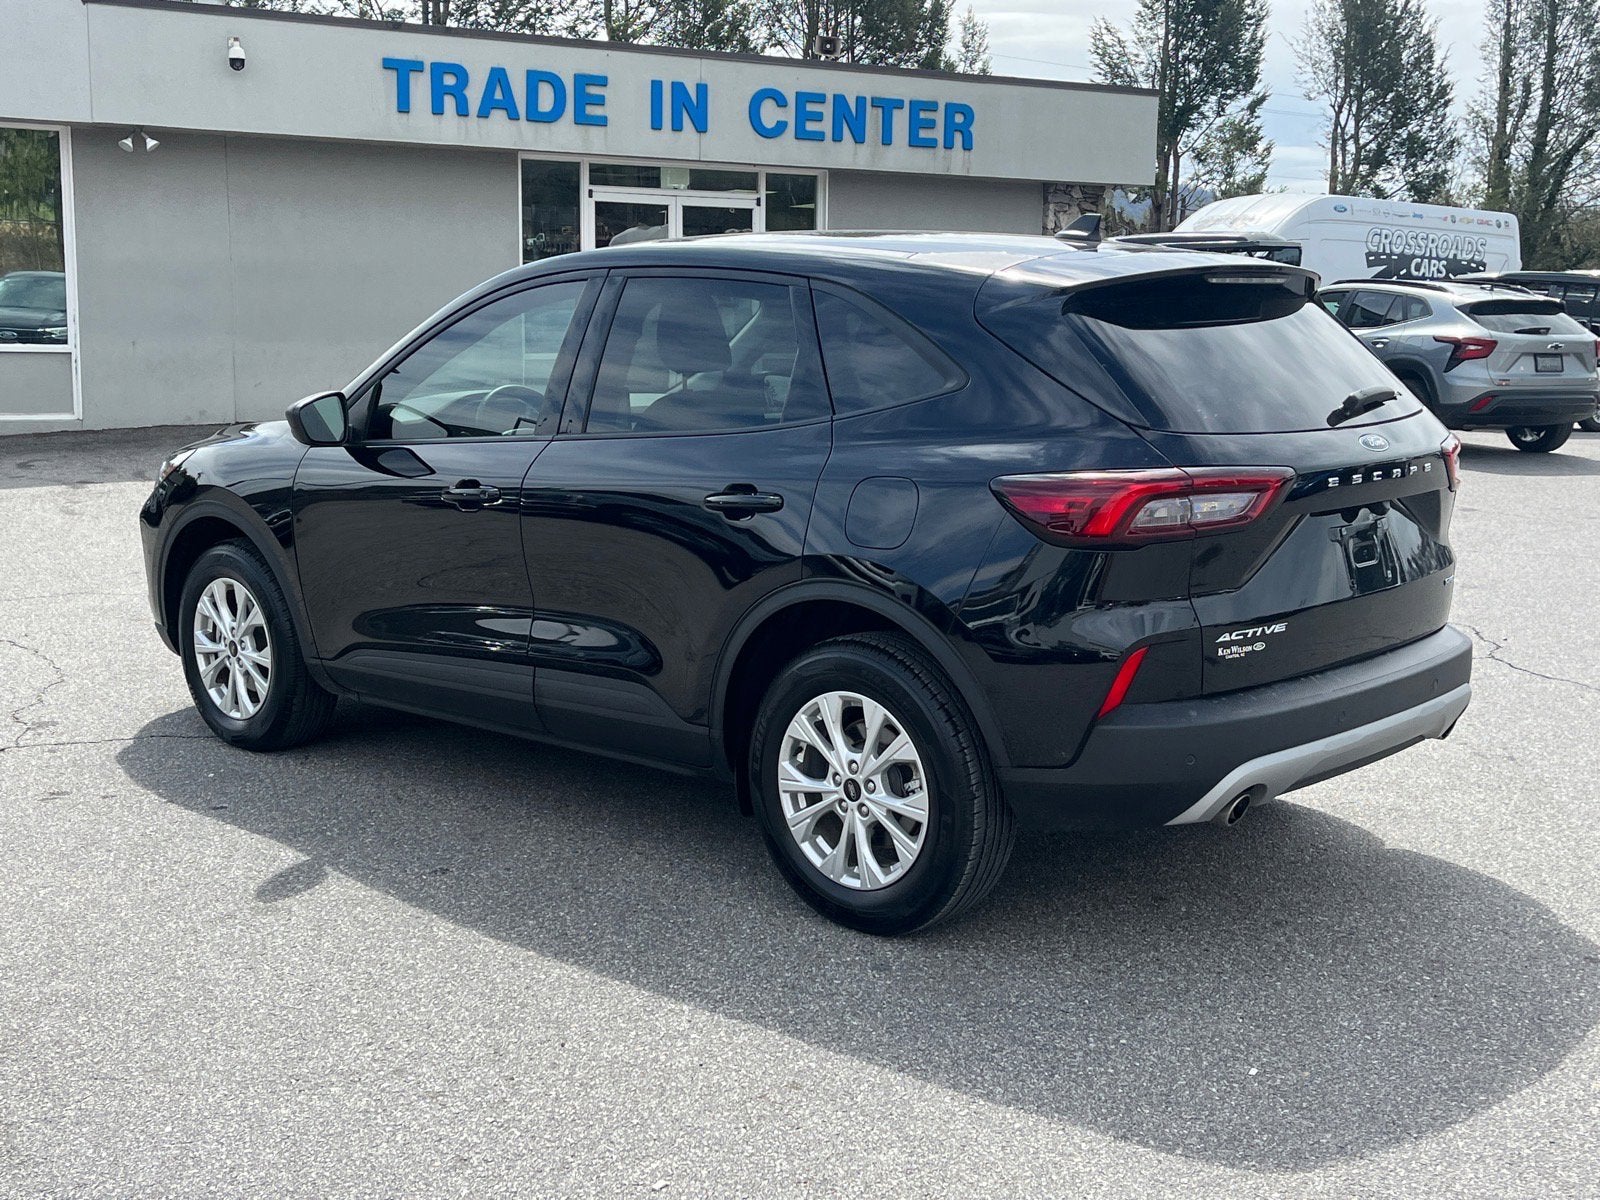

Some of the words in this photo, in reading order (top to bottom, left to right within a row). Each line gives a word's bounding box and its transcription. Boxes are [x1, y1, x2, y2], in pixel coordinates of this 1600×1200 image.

[382, 57, 608, 127] TRADE
[650, 79, 708, 133] IN
[748, 87, 975, 151] CENTER
[1366, 227, 1487, 261] CROSSROADS
[1410, 257, 1447, 279] CARS
[1327, 462, 1432, 487] ESCAPE
[1215, 622, 1288, 643] ACTIVE
